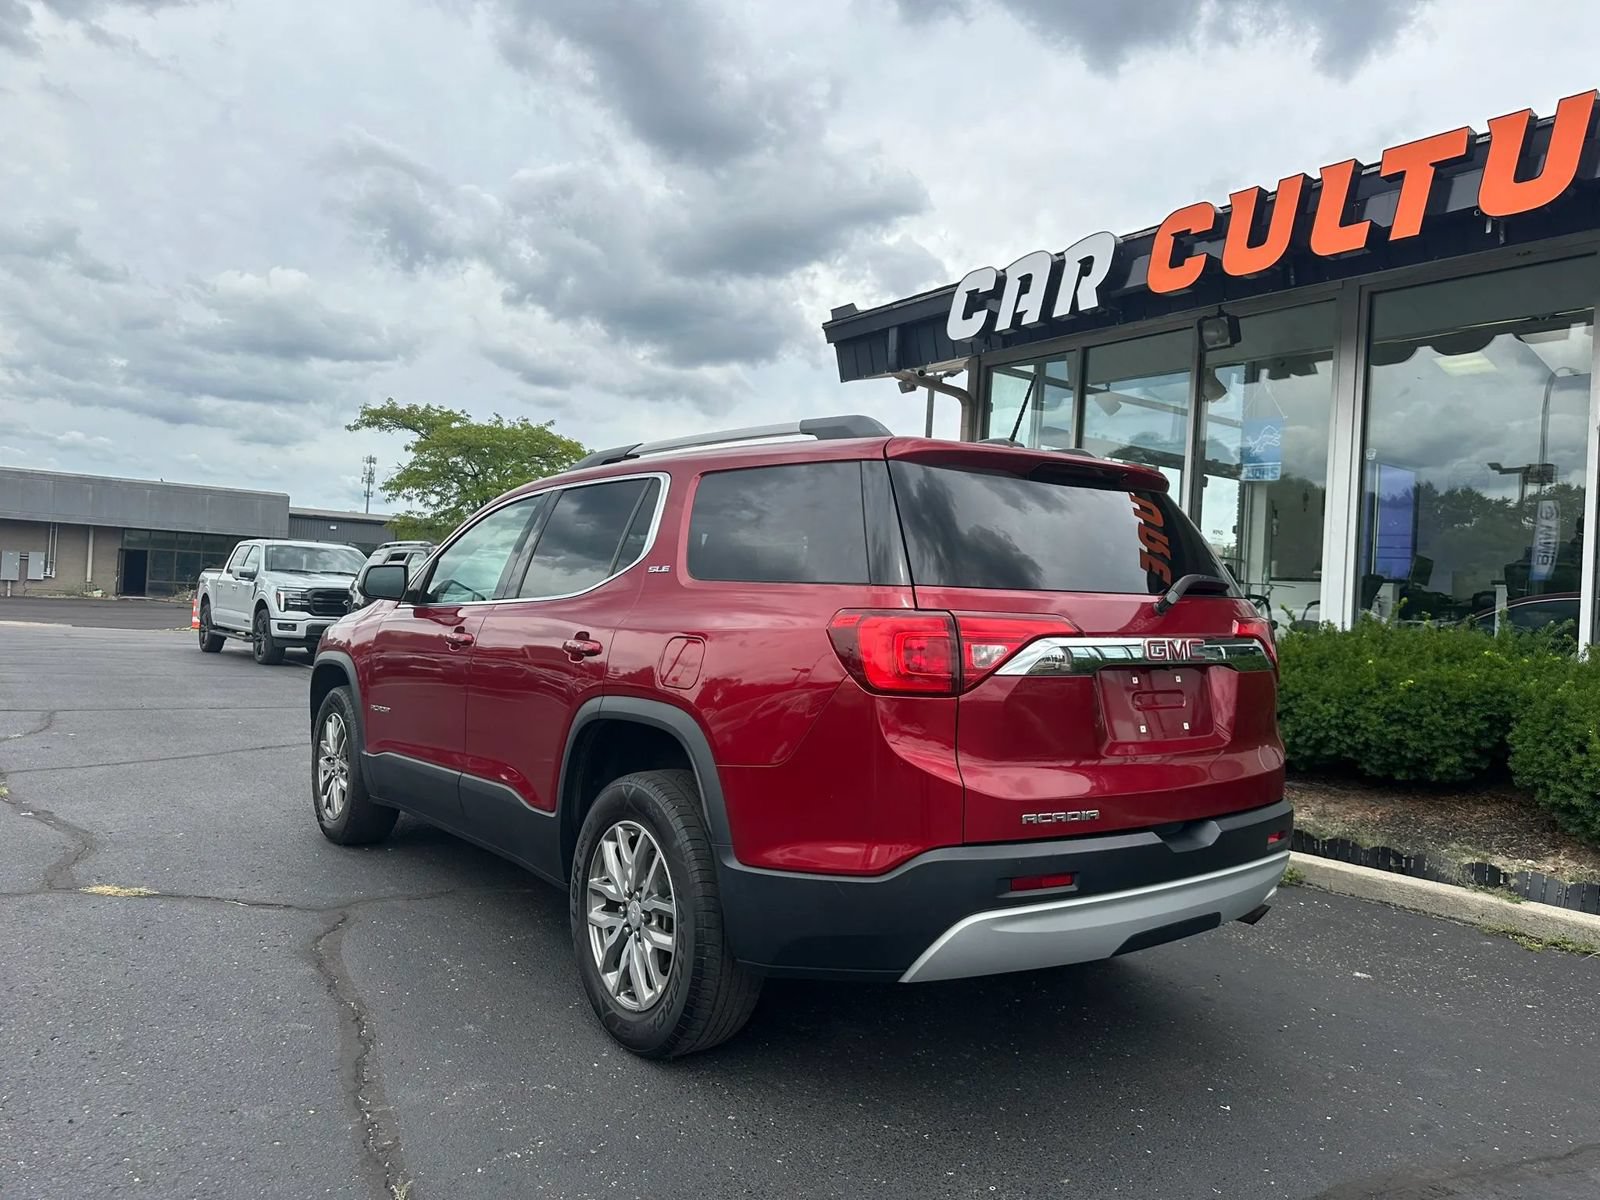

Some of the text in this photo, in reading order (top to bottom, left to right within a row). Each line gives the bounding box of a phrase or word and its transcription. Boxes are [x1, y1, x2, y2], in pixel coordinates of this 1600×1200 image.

[946, 89, 1598, 341] CAR CULTU
[647, 564, 671, 573] SLE
[1146, 638, 1206, 661] GMC
[1021, 809, 1100, 825] ACADIA
